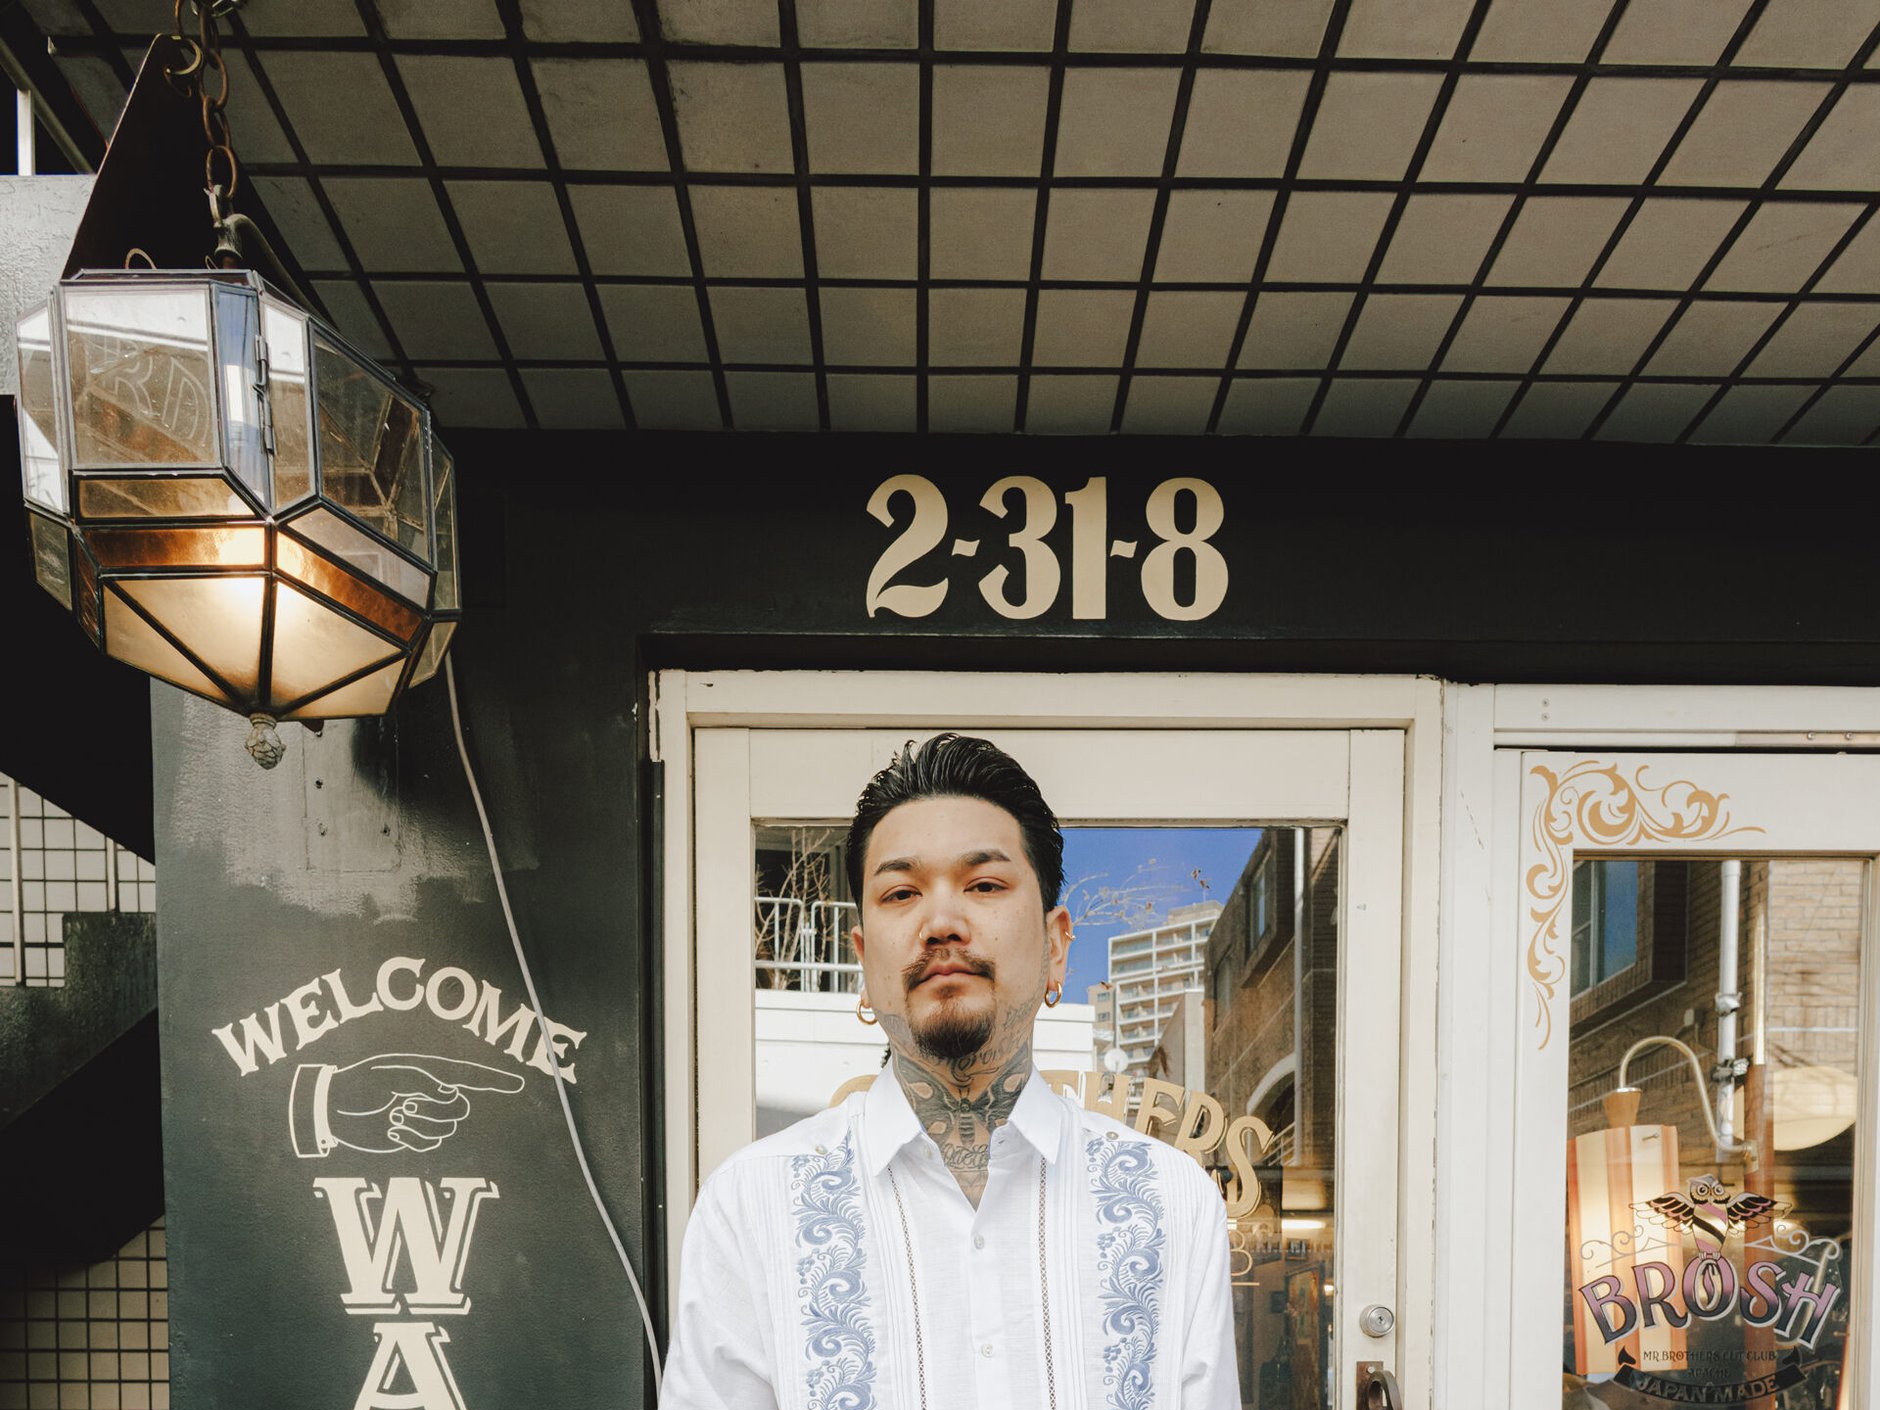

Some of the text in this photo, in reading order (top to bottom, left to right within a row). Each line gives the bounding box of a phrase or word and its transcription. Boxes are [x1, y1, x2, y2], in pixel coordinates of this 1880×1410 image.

[866, 474, 1229, 621] 2-31-8
[212, 956, 587, 1083] WELCOME
[1578, 1254, 1841, 1348] BROSH
[1635, 1373, 1778, 1403] JAPAN MADE
[1746, 1350, 1777, 1362] CLUB
